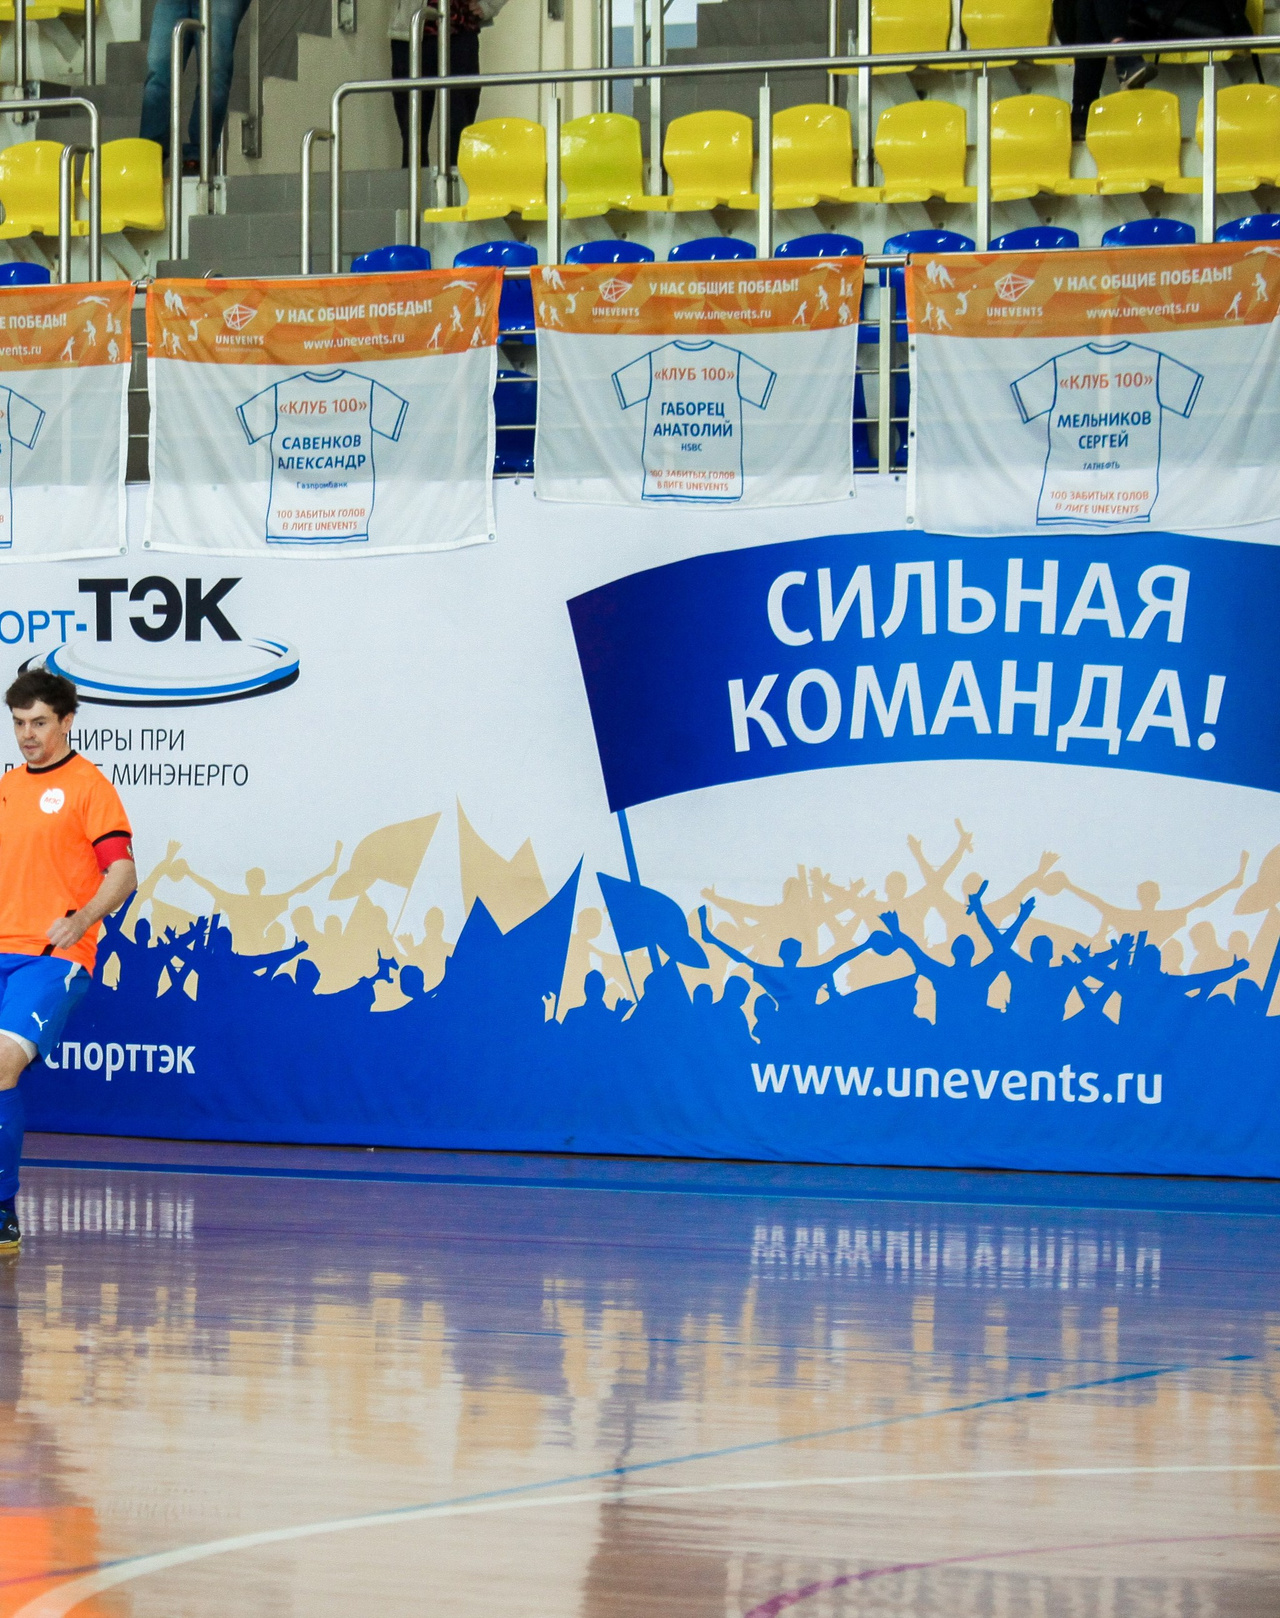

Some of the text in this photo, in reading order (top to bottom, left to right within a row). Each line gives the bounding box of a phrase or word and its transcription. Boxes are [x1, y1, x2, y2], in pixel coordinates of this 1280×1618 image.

[1053, 267, 1232, 291] У НАС ОБЩИЕ ПОБЕДЫ!
[650, 279, 799, 298] У НАС ОБЩИЕ ПОБЕДЫ!
[275, 300, 433, 323] У НАС ОБЩИЕ ПОБЕДЫ!
[592, 307, 640, 317] UNEVENTS
[674, 308, 772, 321] www.unevents.ru
[987, 306, 1043, 317] UNEVENTS
[1086, 302, 1200, 319] www.unevents.ru
[9, 313, 67, 330] ПОБЕДЫ!
[215, 334, 264, 345] UNEVENTS
[303, 334, 405, 350] www.unevents.ru
[654, 367, 735, 381] «КЛУБ 100»
[1059, 372, 1153, 390] «КЛУБ 100»
[279, 398, 367, 415] «КЛУБ 100»
[661, 401, 725, 419] ГАБОРЕЦ
[1057, 411, 1152, 428] МЕЛЬНИКОВ
[653, 420, 733, 438] АНАТОЛИЙ
[282, 435, 361, 450] САВЕНКОВ
[681, 444, 703, 452] HSBC
[1078, 430, 1129, 450] СЕРГЕЙ
[278, 454, 366, 471] АЛЕКСАНДР
[1082, 461, 1120, 471] ТАТНЕФТЬ
[650, 469, 735, 480] 100 ЗАБИТЫХ ГОЛОВ
[296, 480, 349, 491] Газпромбанк
[657, 481, 729, 491] В ЛИГЕ UNEVENTS
[1050, 490, 1149, 501] 100 ЗАБИТЫХ ГОЛОВ
[276, 507, 365, 519] 100 ЗАБИТЫХ ГОЛОВ
[1054, 501, 1140, 514] В ЛИГЕ UNEVENTS
[282, 520, 357, 531] В ЛИГЕ UNEVENTS
[766, 557, 1192, 647] СИЛЬНАЯ
[727, 659, 1227, 755] КОМАНДА!
[69, 728, 185, 752] НИРЫ ПРИ
[111, 763, 249, 787] МИНЭНЕРГО
[750, 1061, 1163, 1105] www.unevents.ru
